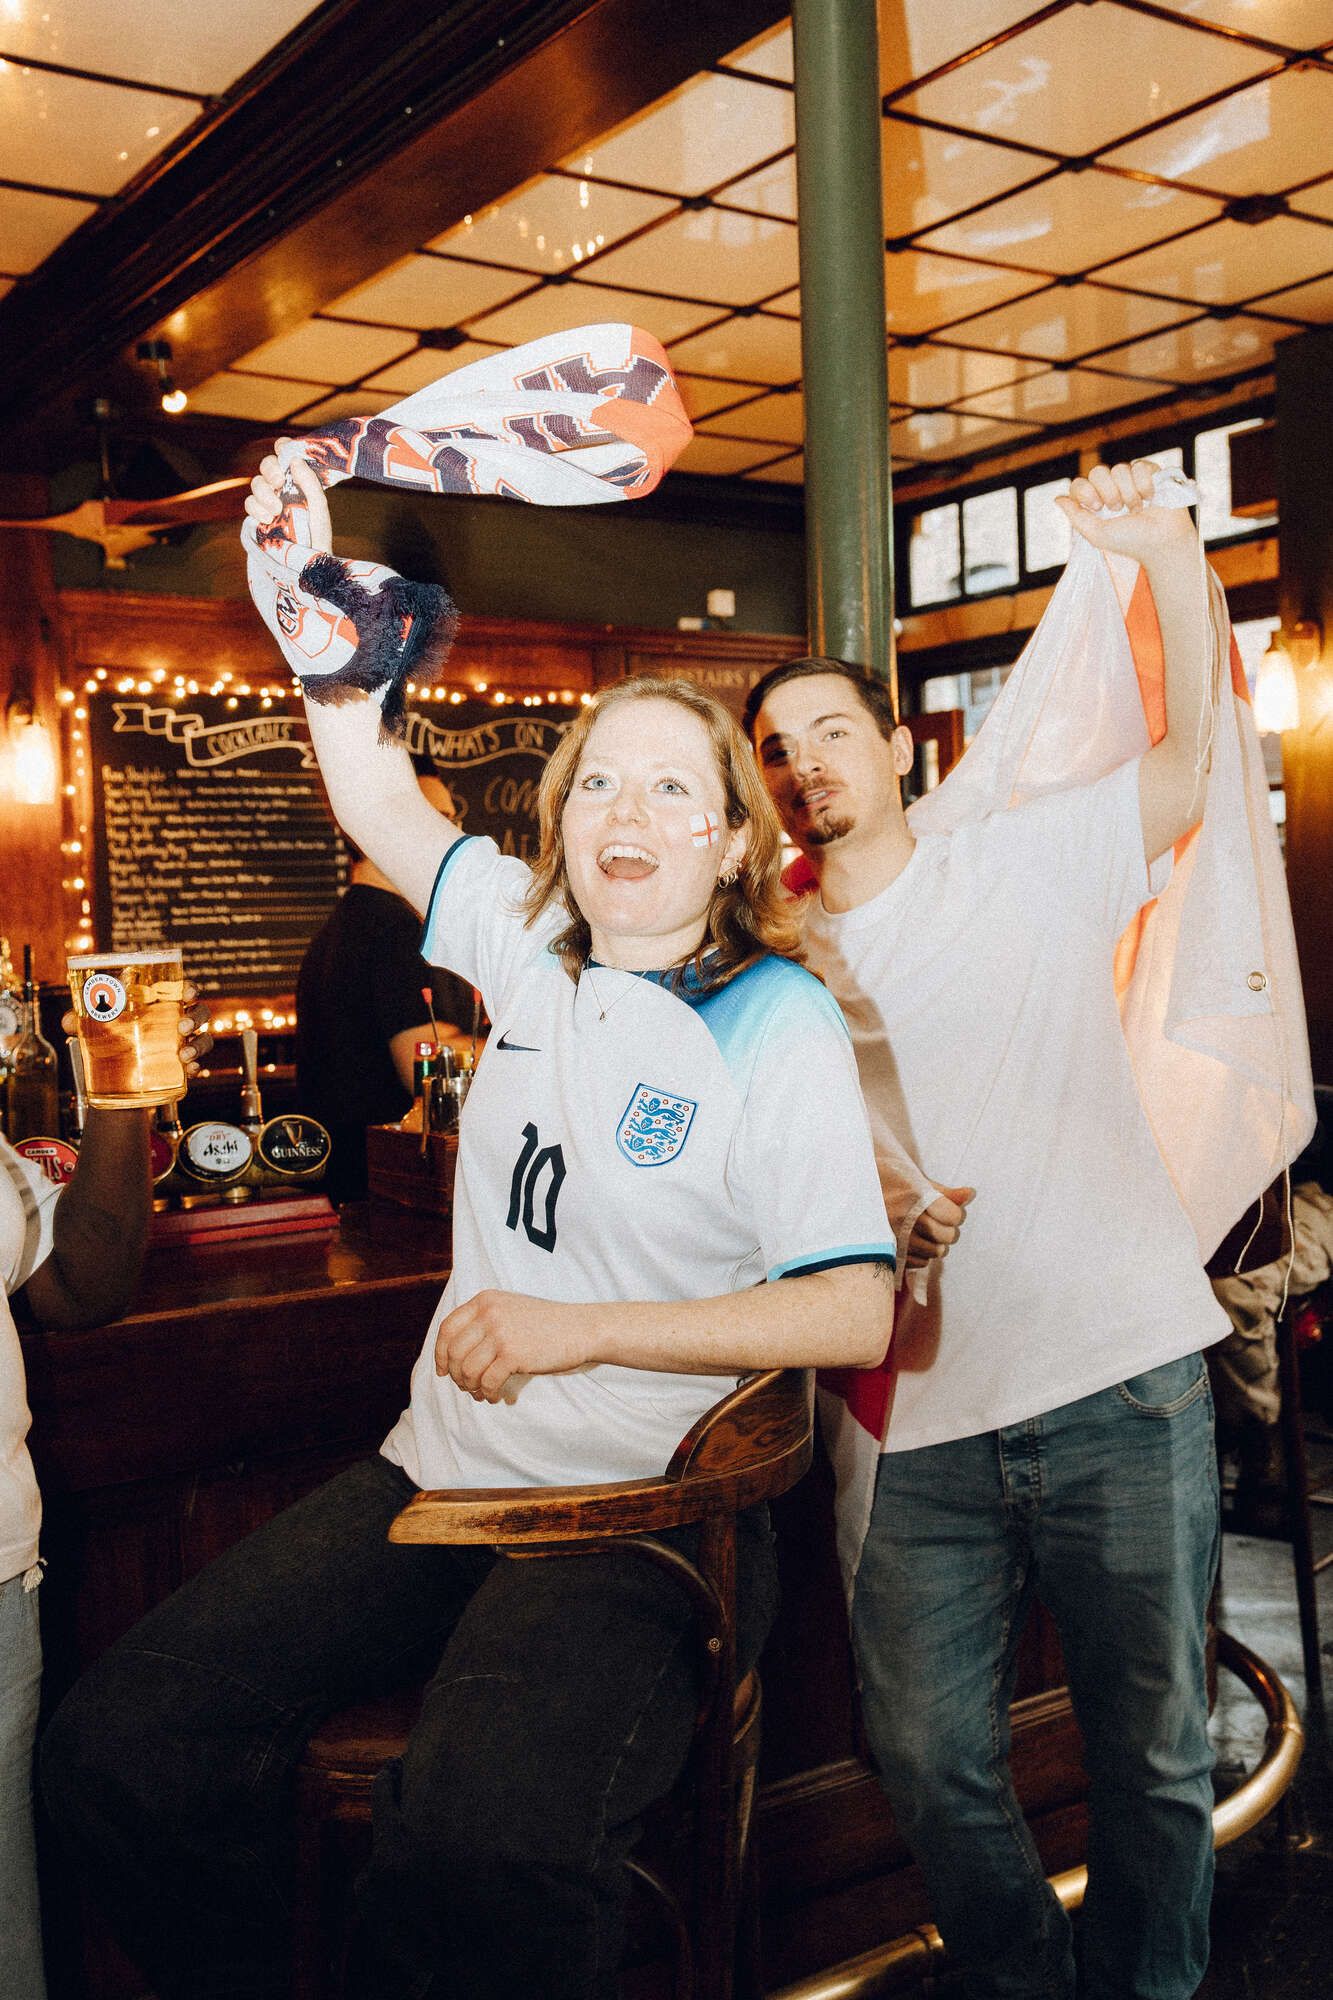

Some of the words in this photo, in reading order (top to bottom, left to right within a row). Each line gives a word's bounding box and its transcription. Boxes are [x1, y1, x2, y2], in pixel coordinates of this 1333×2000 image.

[206, 722, 293, 757] COCKTAILS
[514, 722, 544, 749] ON
[85, 976, 103, 995] CAMDEN
[105, 977, 121, 993] TOWN
[90, 1007, 119, 1019] BREWERY
[203, 1140, 239, 1157] Asahi
[271, 1146, 322, 1159] GUINNESS
[505, 1121, 567, 1253] 10
